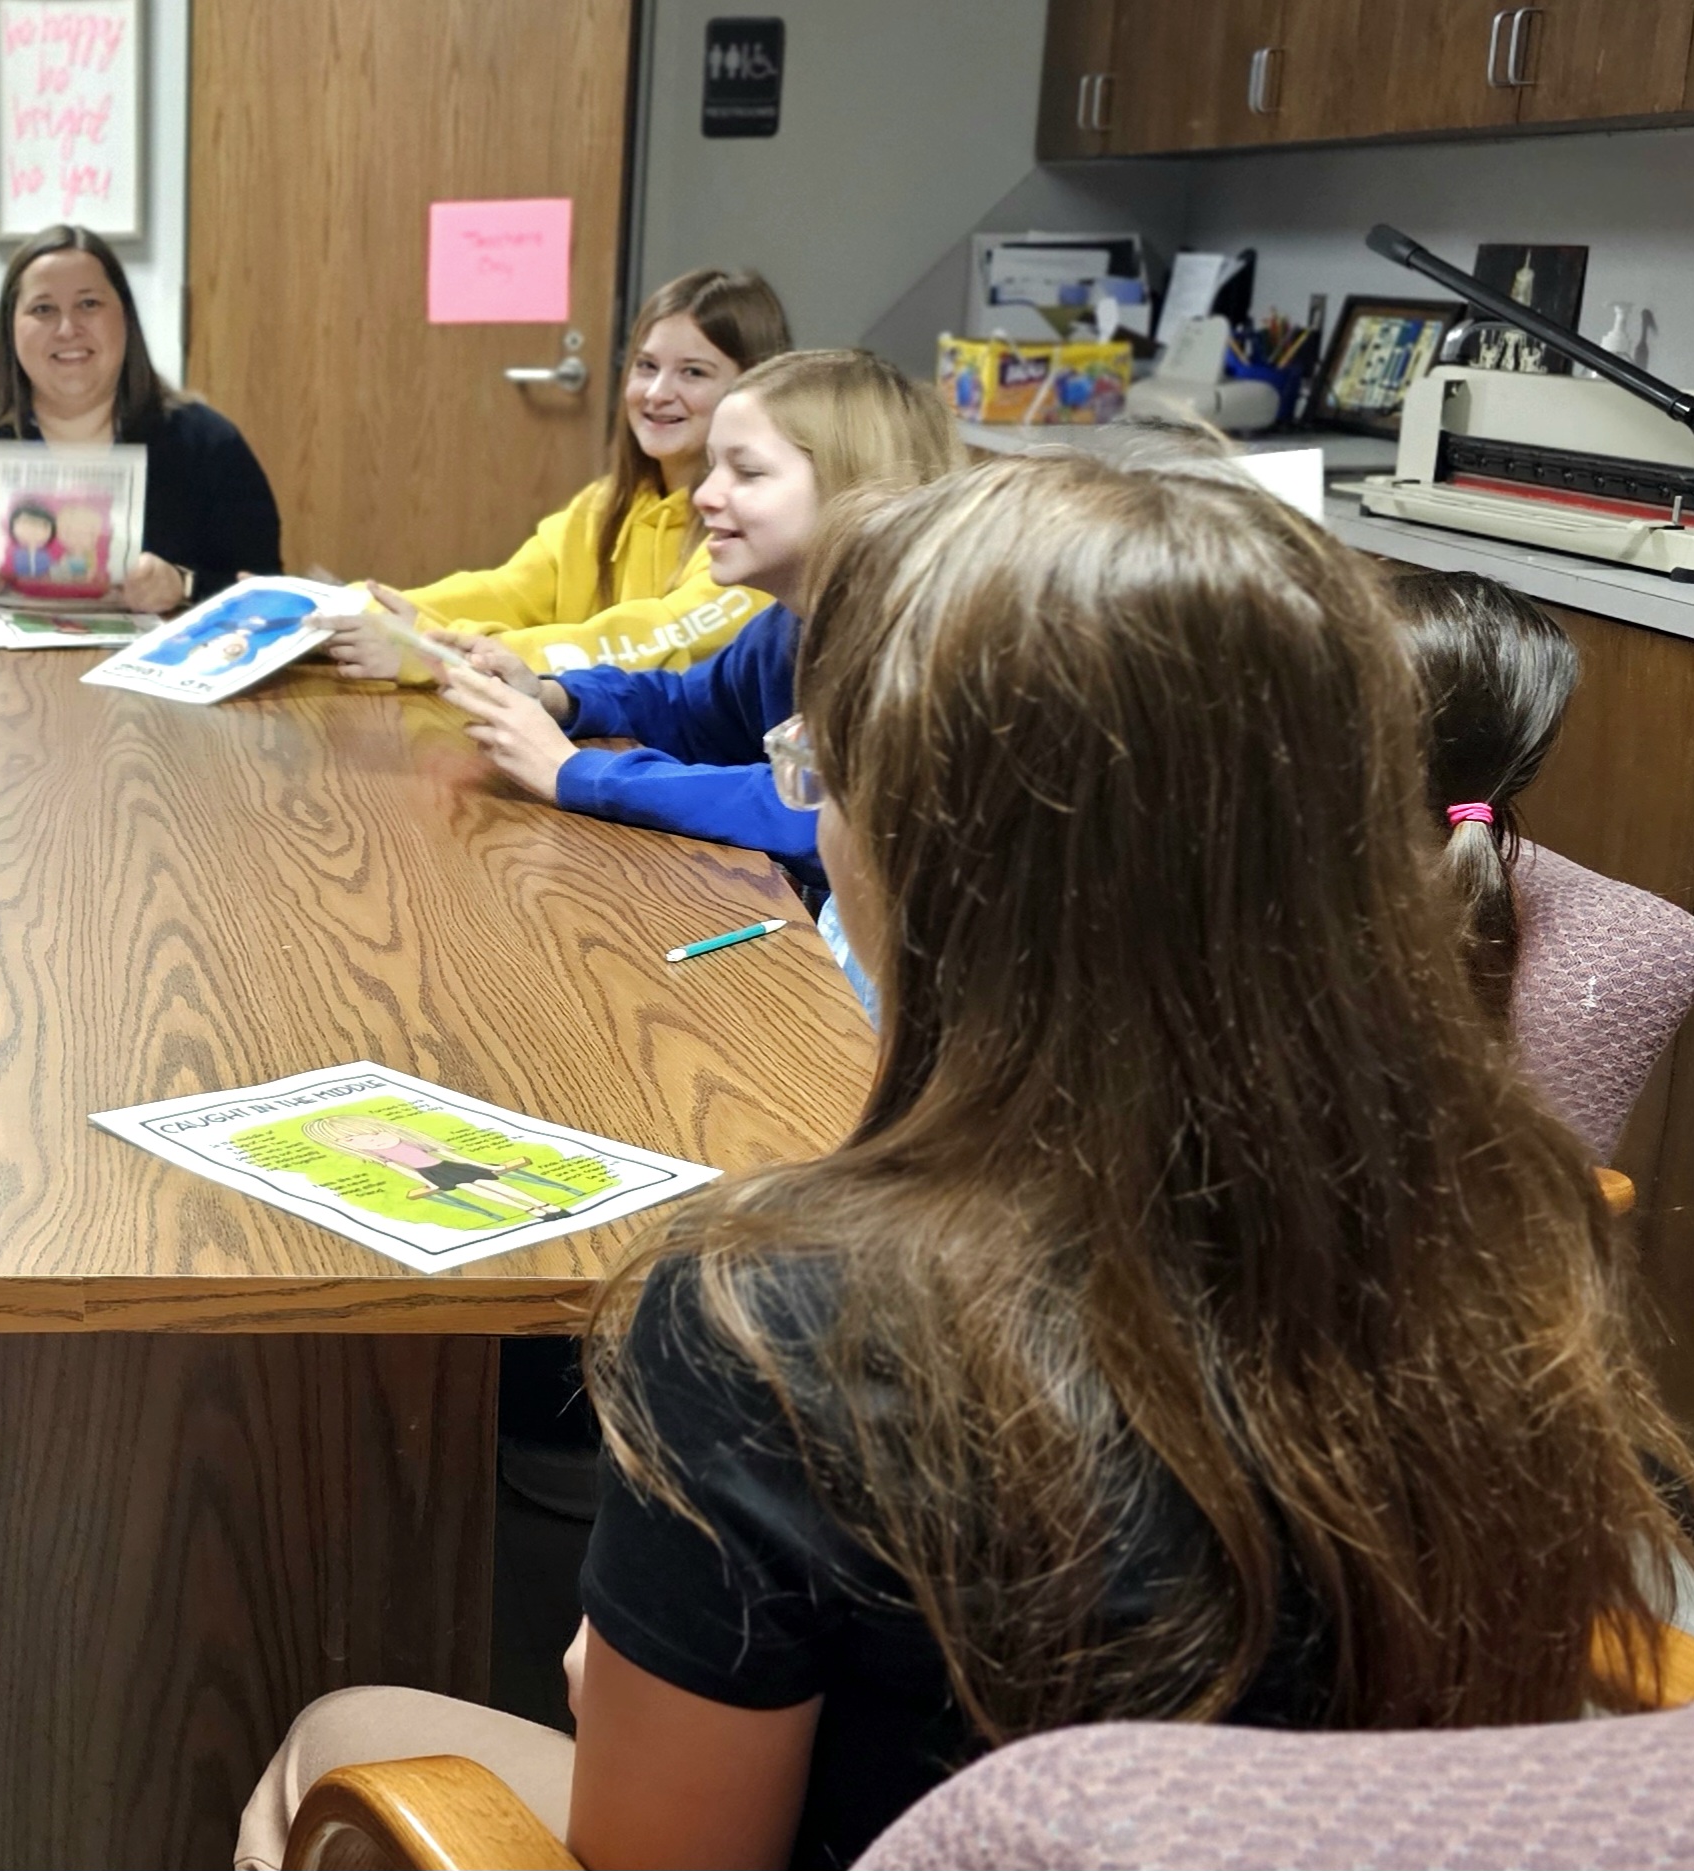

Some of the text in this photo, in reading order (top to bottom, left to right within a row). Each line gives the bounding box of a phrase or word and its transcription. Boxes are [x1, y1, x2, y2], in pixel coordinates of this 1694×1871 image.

[160, 1079, 387, 1134] CAUGHT IN THE MIDDLE
